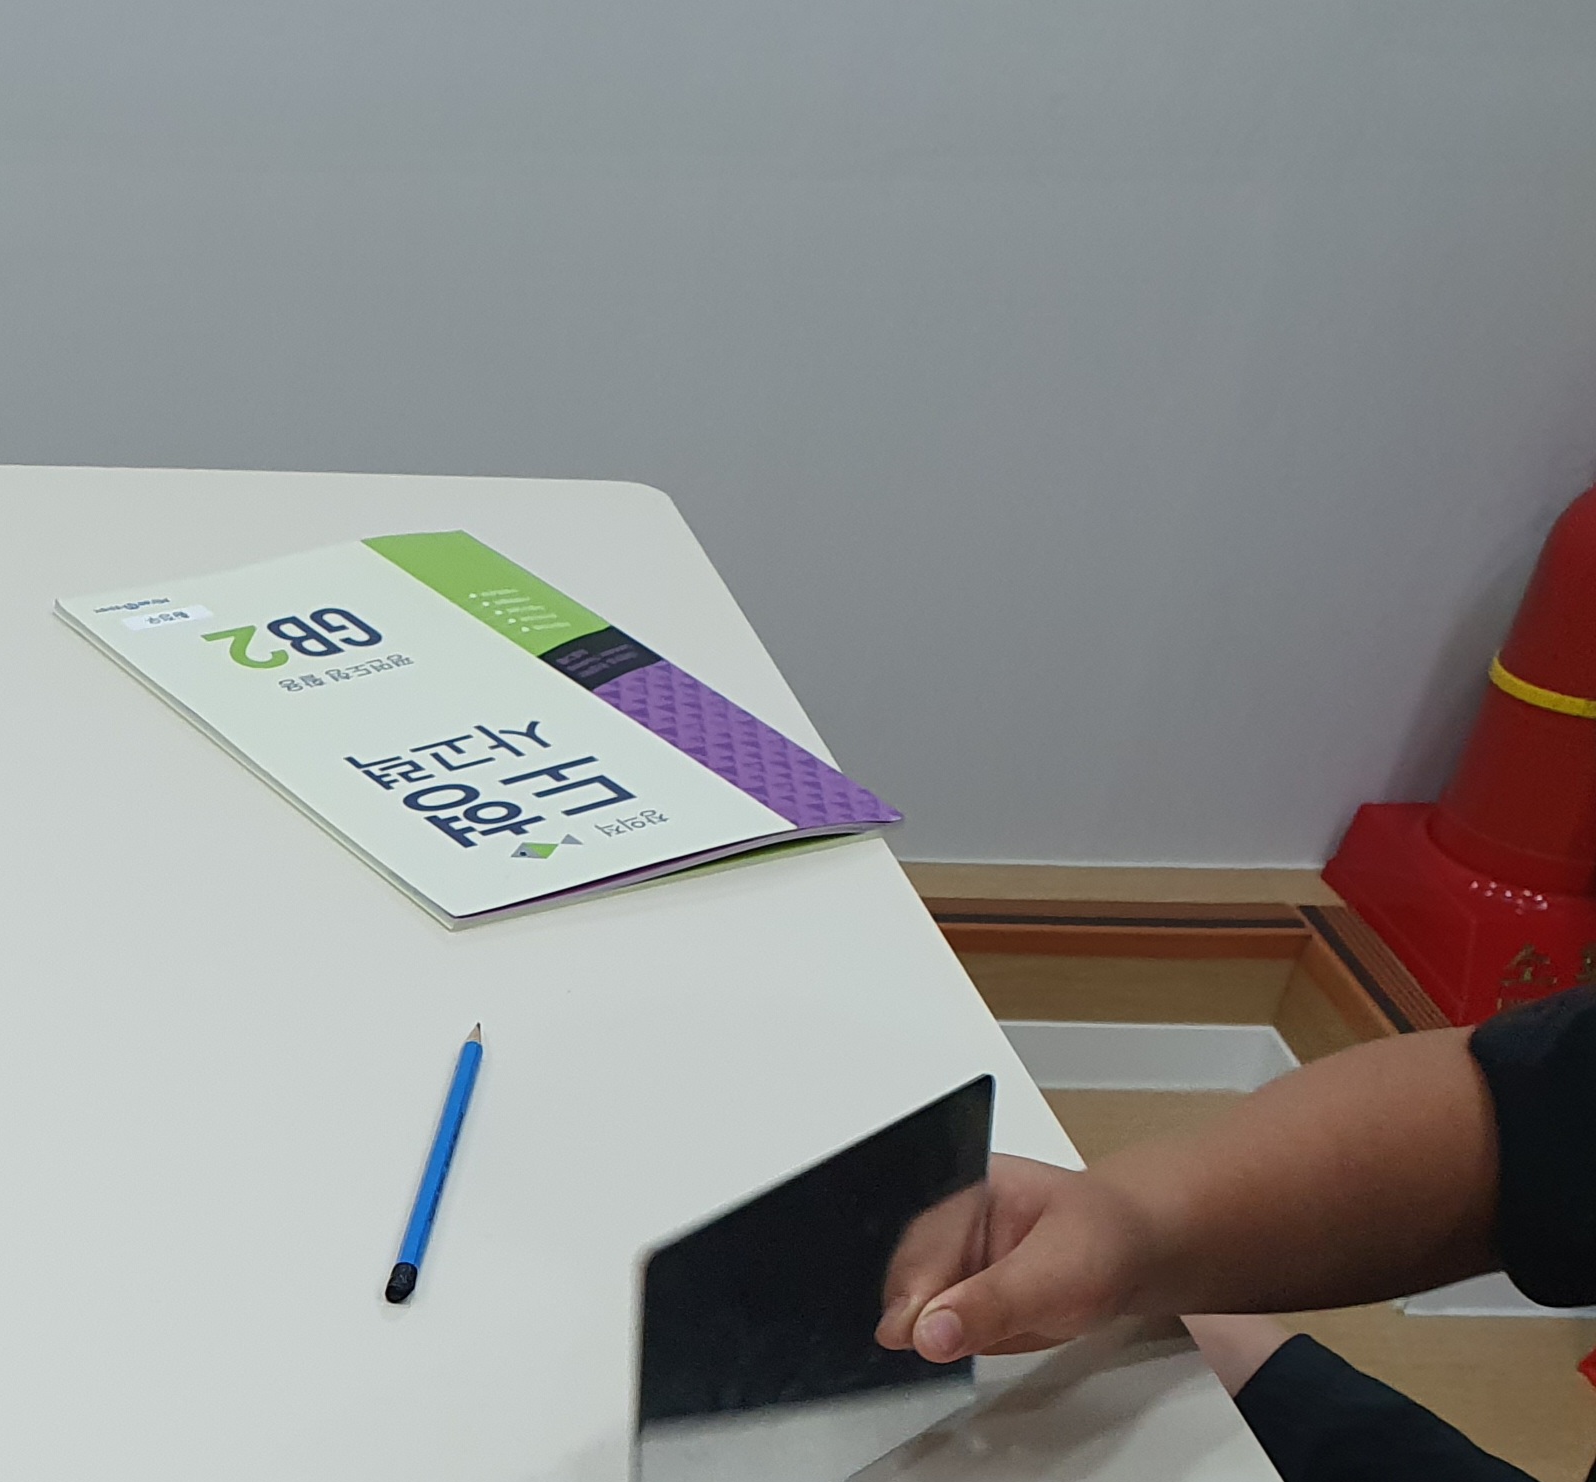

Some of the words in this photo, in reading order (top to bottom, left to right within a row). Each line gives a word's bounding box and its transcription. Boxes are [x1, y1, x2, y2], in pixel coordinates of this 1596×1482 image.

[200, 608, 383, 669] GB2
[325, 653, 414, 682] 평면도형
[343, 721, 551, 790] 사고력
[402, 755, 637, 848] 도형
[594, 809, 669, 837] 창의적
